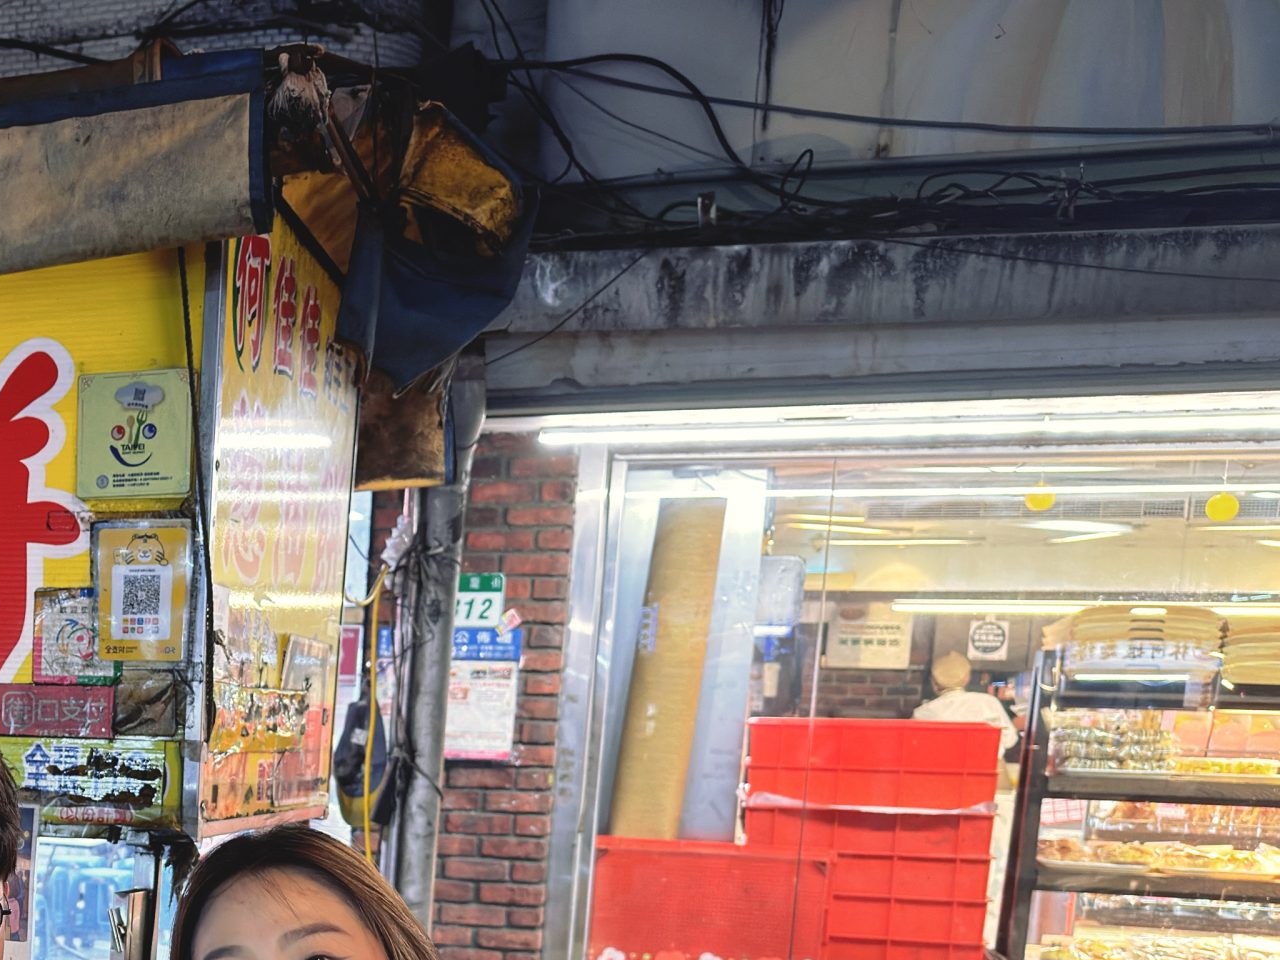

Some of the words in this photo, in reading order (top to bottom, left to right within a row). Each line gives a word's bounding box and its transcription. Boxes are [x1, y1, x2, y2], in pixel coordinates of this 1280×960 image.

[455, 598, 493, 620] 12
[2, 692, 107, 727] 街口支付
